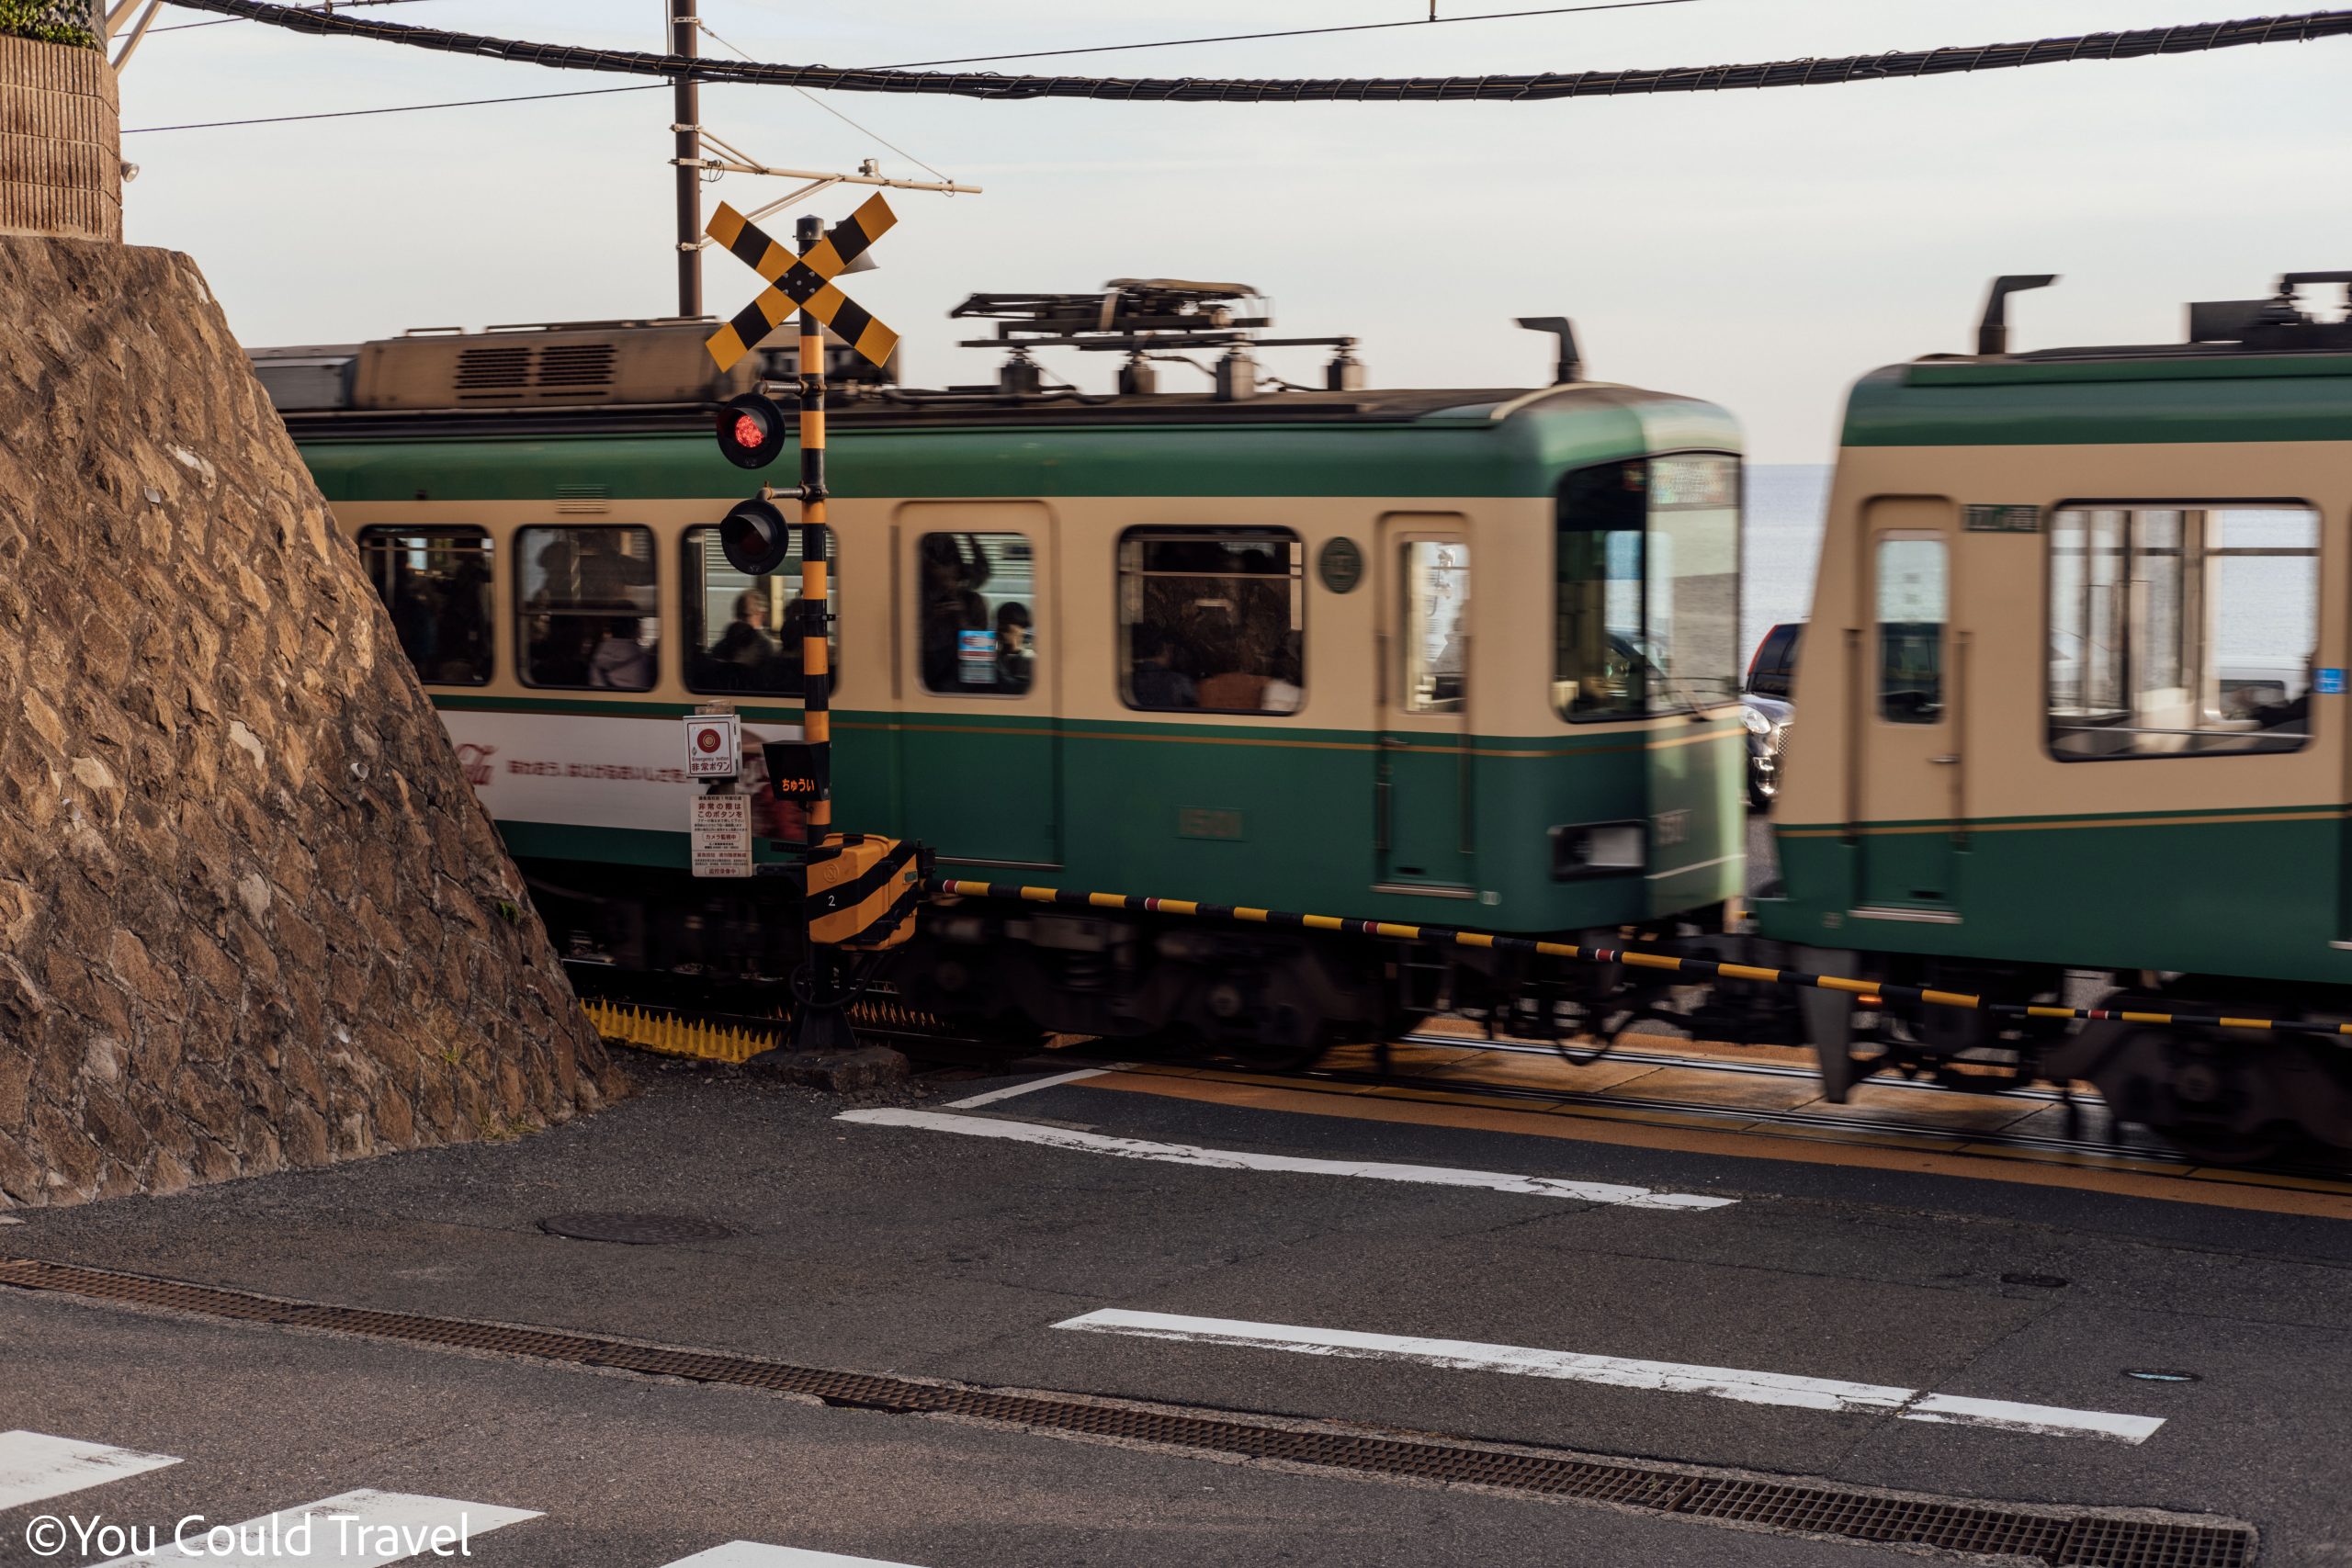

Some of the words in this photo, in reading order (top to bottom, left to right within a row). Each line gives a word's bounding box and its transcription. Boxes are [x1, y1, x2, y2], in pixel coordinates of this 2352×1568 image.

[691, 761, 730, 773] 非常ボタン
[782, 778, 815, 792] ちゅうい
[698, 802, 741, 810] 非常の際は
[697, 810, 742, 818] このボタンを
[828, 895, 835, 907] 2
